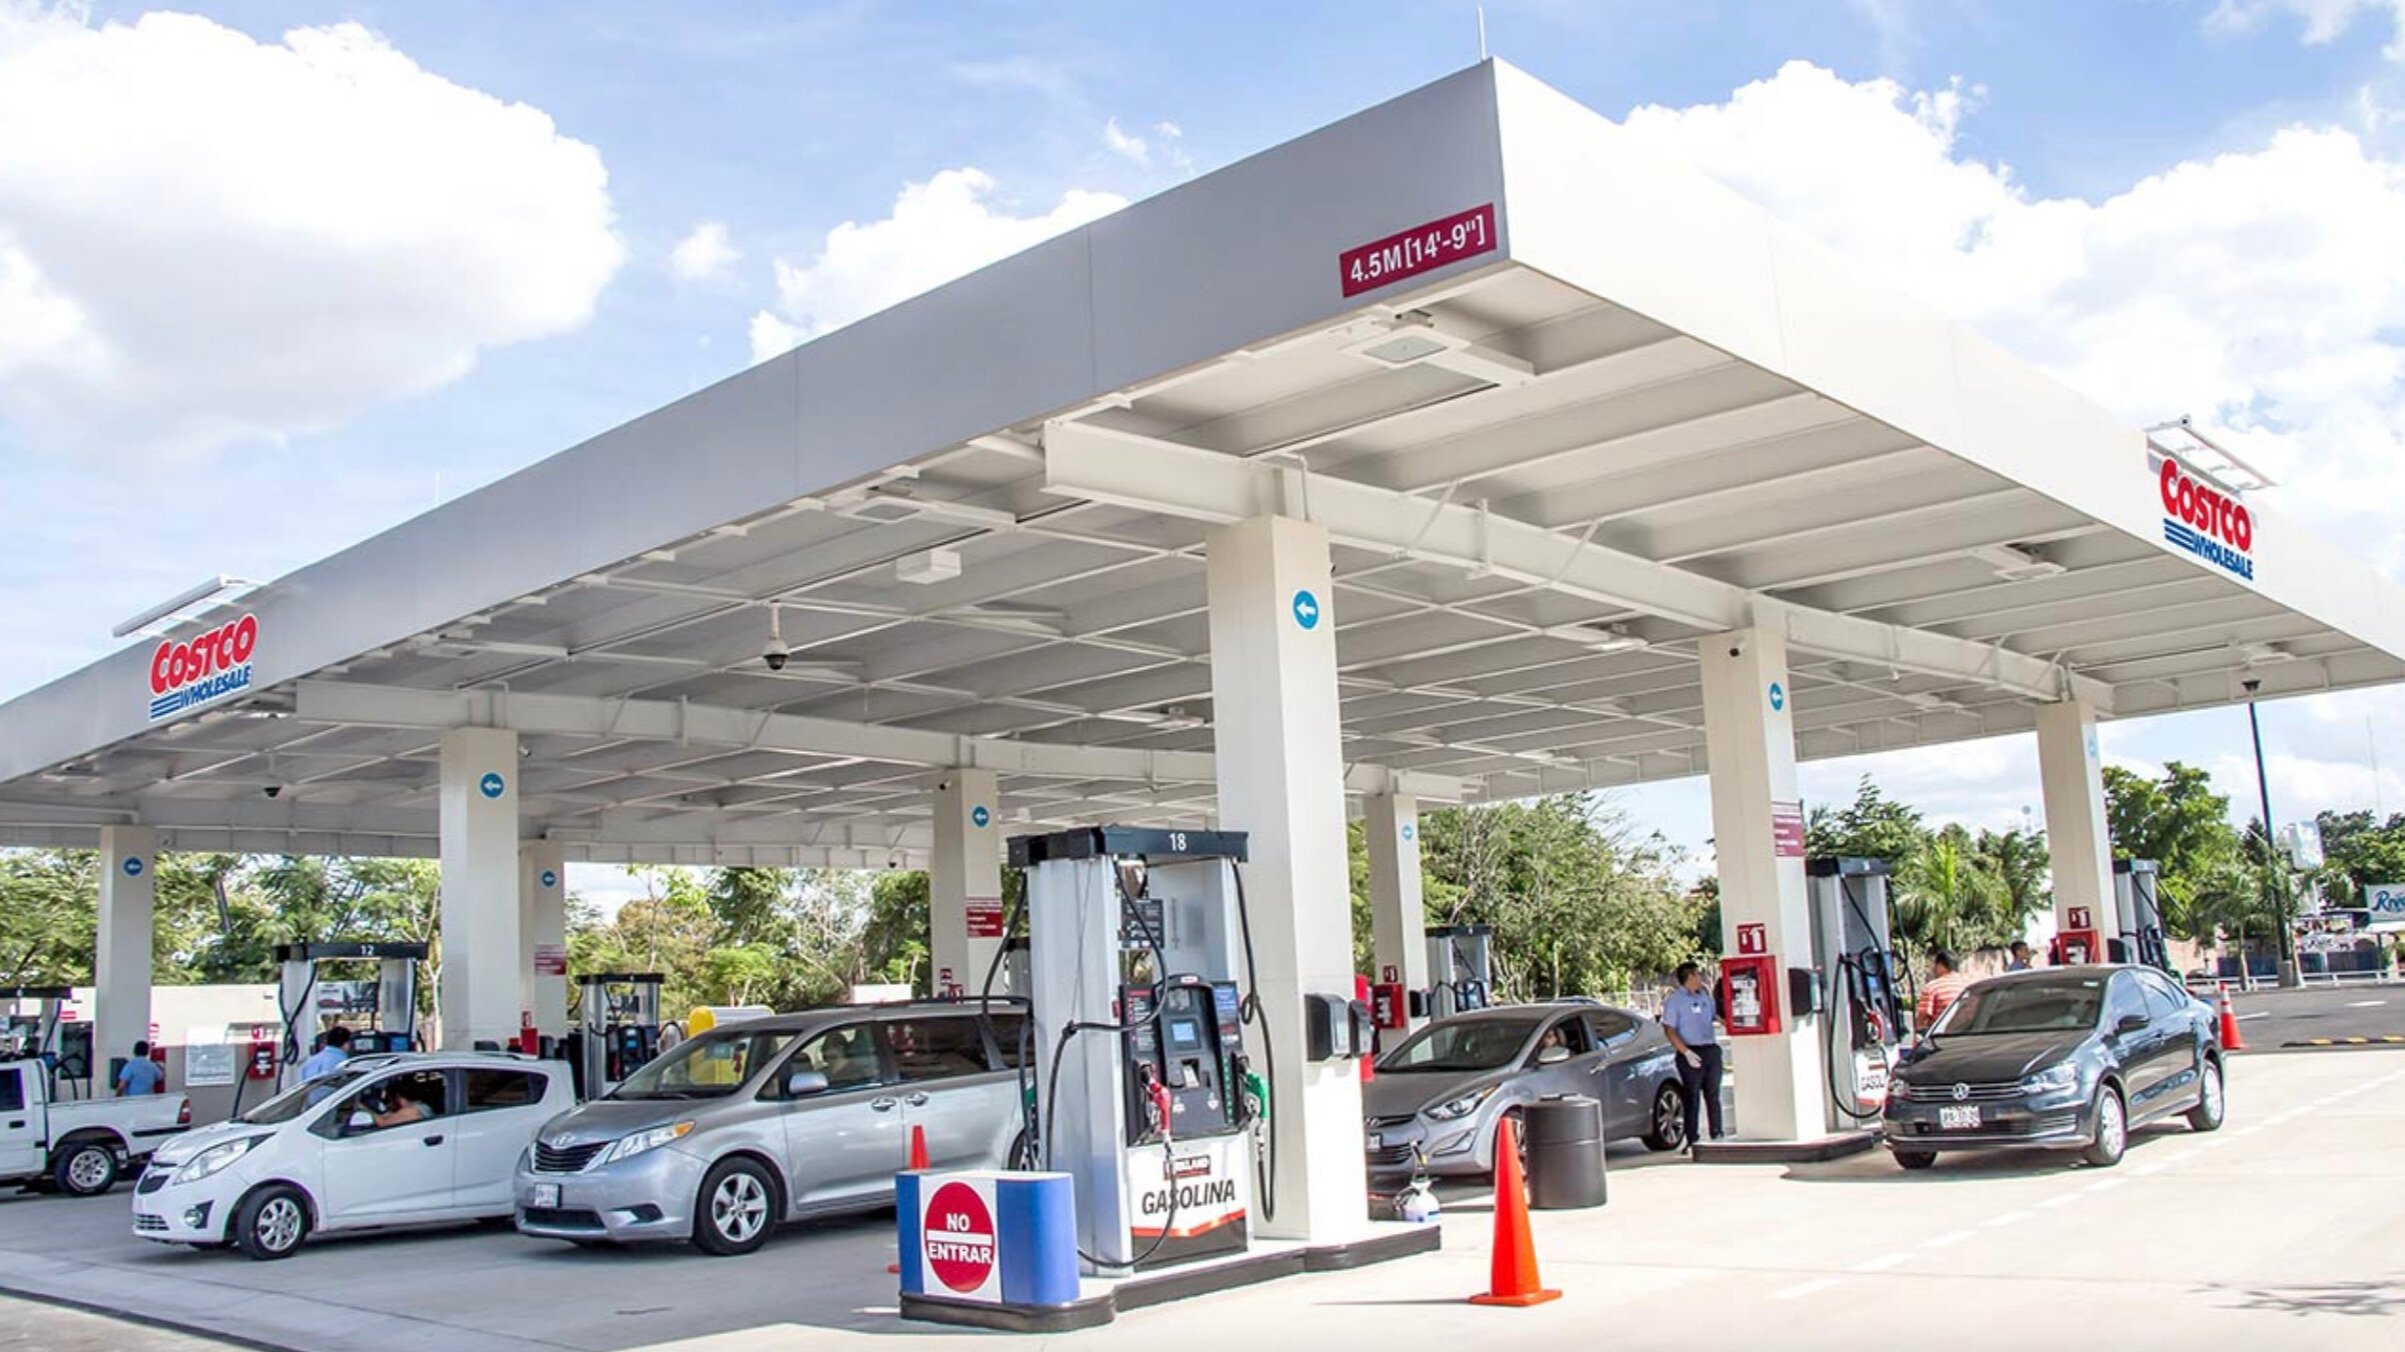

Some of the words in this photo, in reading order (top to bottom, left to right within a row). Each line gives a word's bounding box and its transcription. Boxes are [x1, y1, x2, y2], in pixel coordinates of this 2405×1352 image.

[2161, 459, 2252, 552] COSTCO
[2194, 534, 2253, 580] WHOLESALE
[151, 615, 257, 694] COSTCO
[180, 665, 252, 708] WHOLESALE
[1169, 832, 1187, 851] 18
[361, 944, 374, 956] 12
[1142, 1179, 1236, 1215] GASOLINA
[945, 1213, 970, 1232] NO
[927, 1242, 992, 1264] ENTRAR
